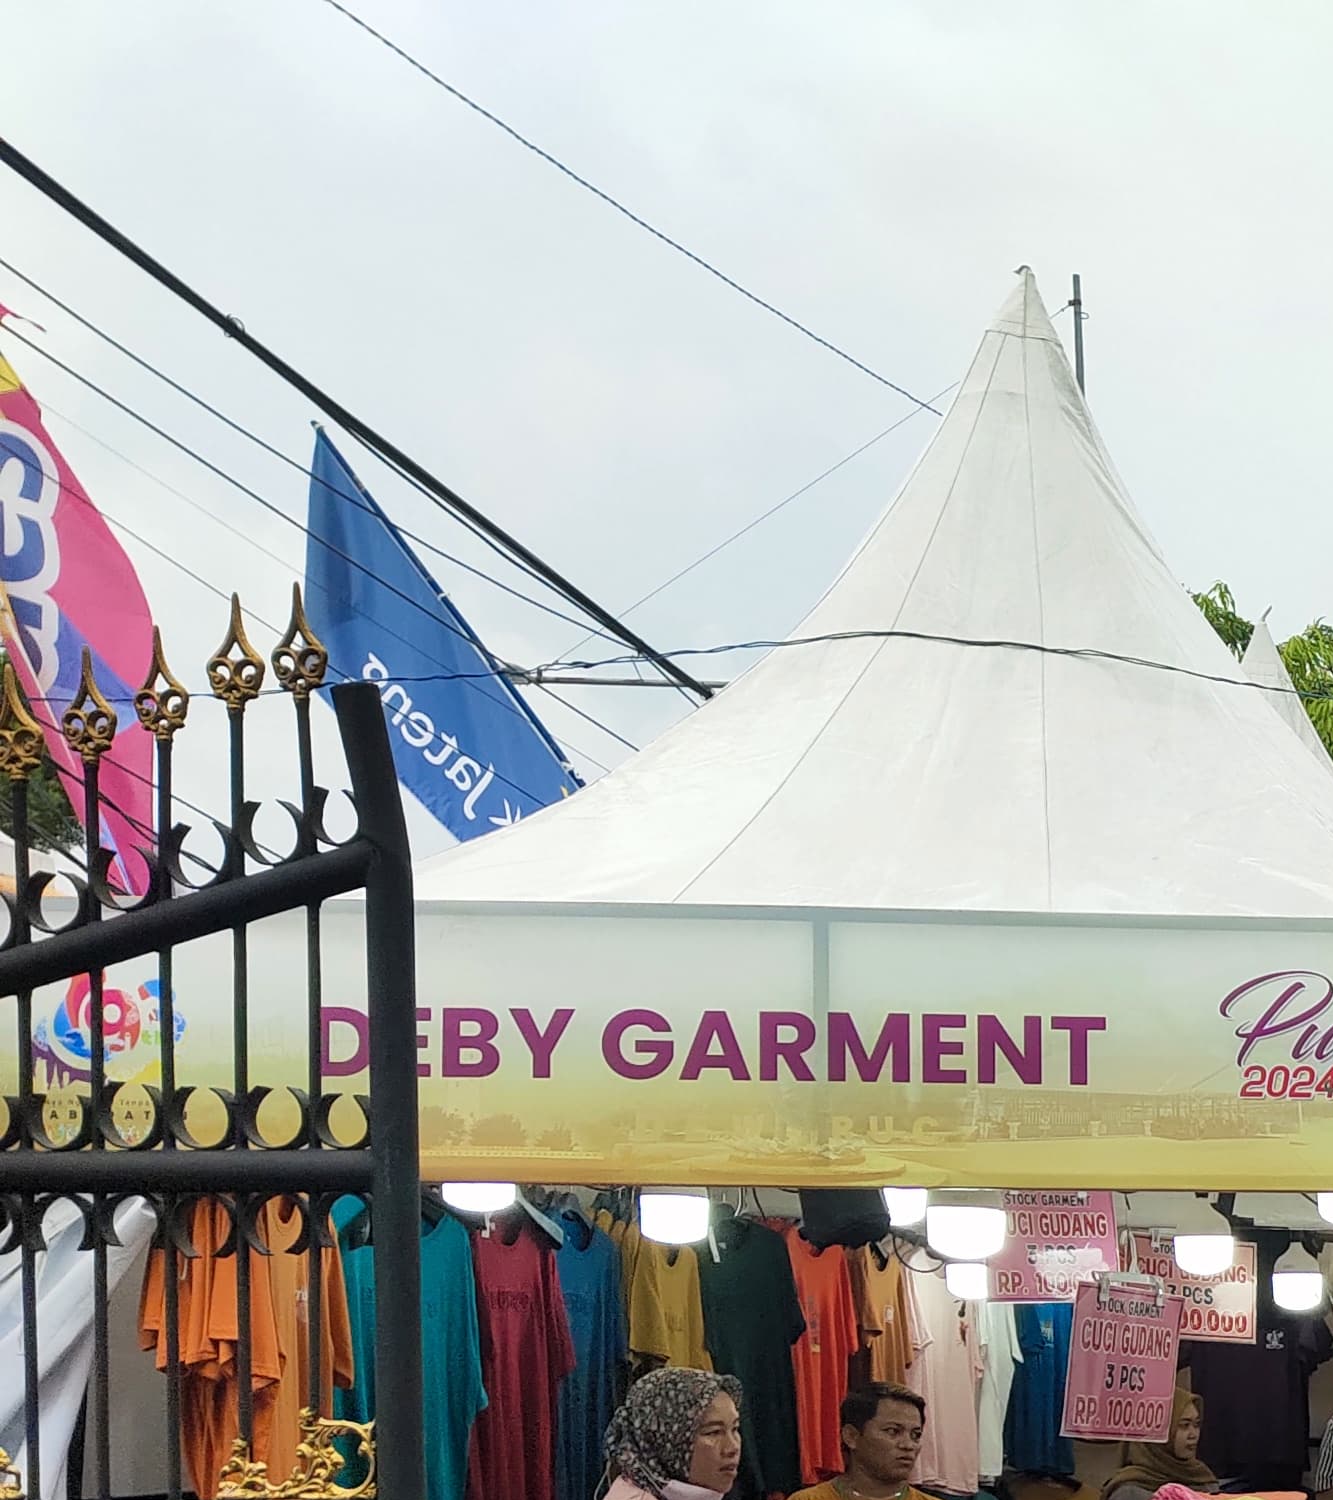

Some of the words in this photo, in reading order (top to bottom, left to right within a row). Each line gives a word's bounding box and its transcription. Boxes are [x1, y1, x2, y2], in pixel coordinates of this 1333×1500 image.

[600, 1008, 1108, 1087] GARMENT
[1004, 1192, 1037, 1207] STOCK
[1038, 1211, 1108, 1239] GUDANG
[1081, 1318, 1117, 1354] CUCI
[1120, 1323, 1172, 1359] GUDANG
[1104, 1363, 1115, 1392] 3
[1119, 1365, 1146, 1392] PCS
[1072, 1396, 1101, 1426] RP.
[1106, 1398, 1165, 1430] 100.000
